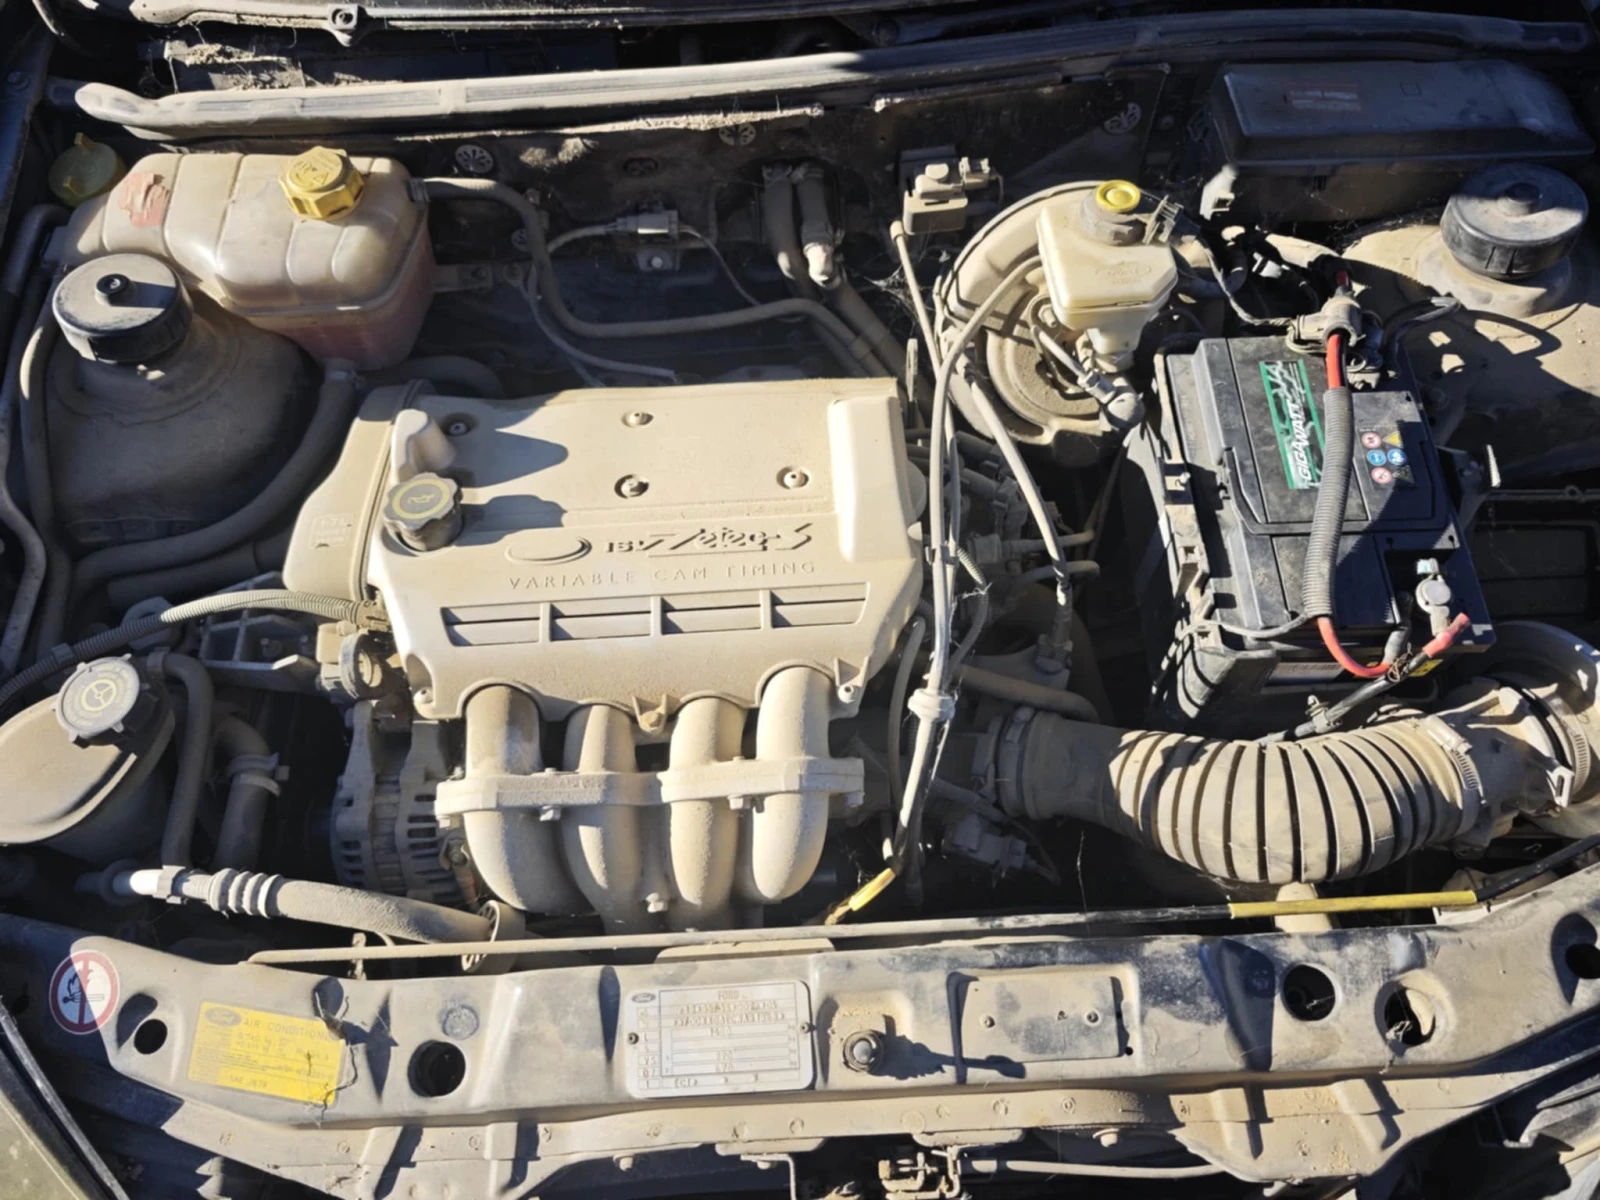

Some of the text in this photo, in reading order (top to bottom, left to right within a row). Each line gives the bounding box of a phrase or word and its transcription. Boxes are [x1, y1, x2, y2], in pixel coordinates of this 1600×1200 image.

[1286, 399, 1313, 481] GIGAWATT
[508, 561, 816, 590] VARIABLE CAM TIMING
[717, 989, 740, 1001] FORD
[243, 1018, 262, 1030] AIR
